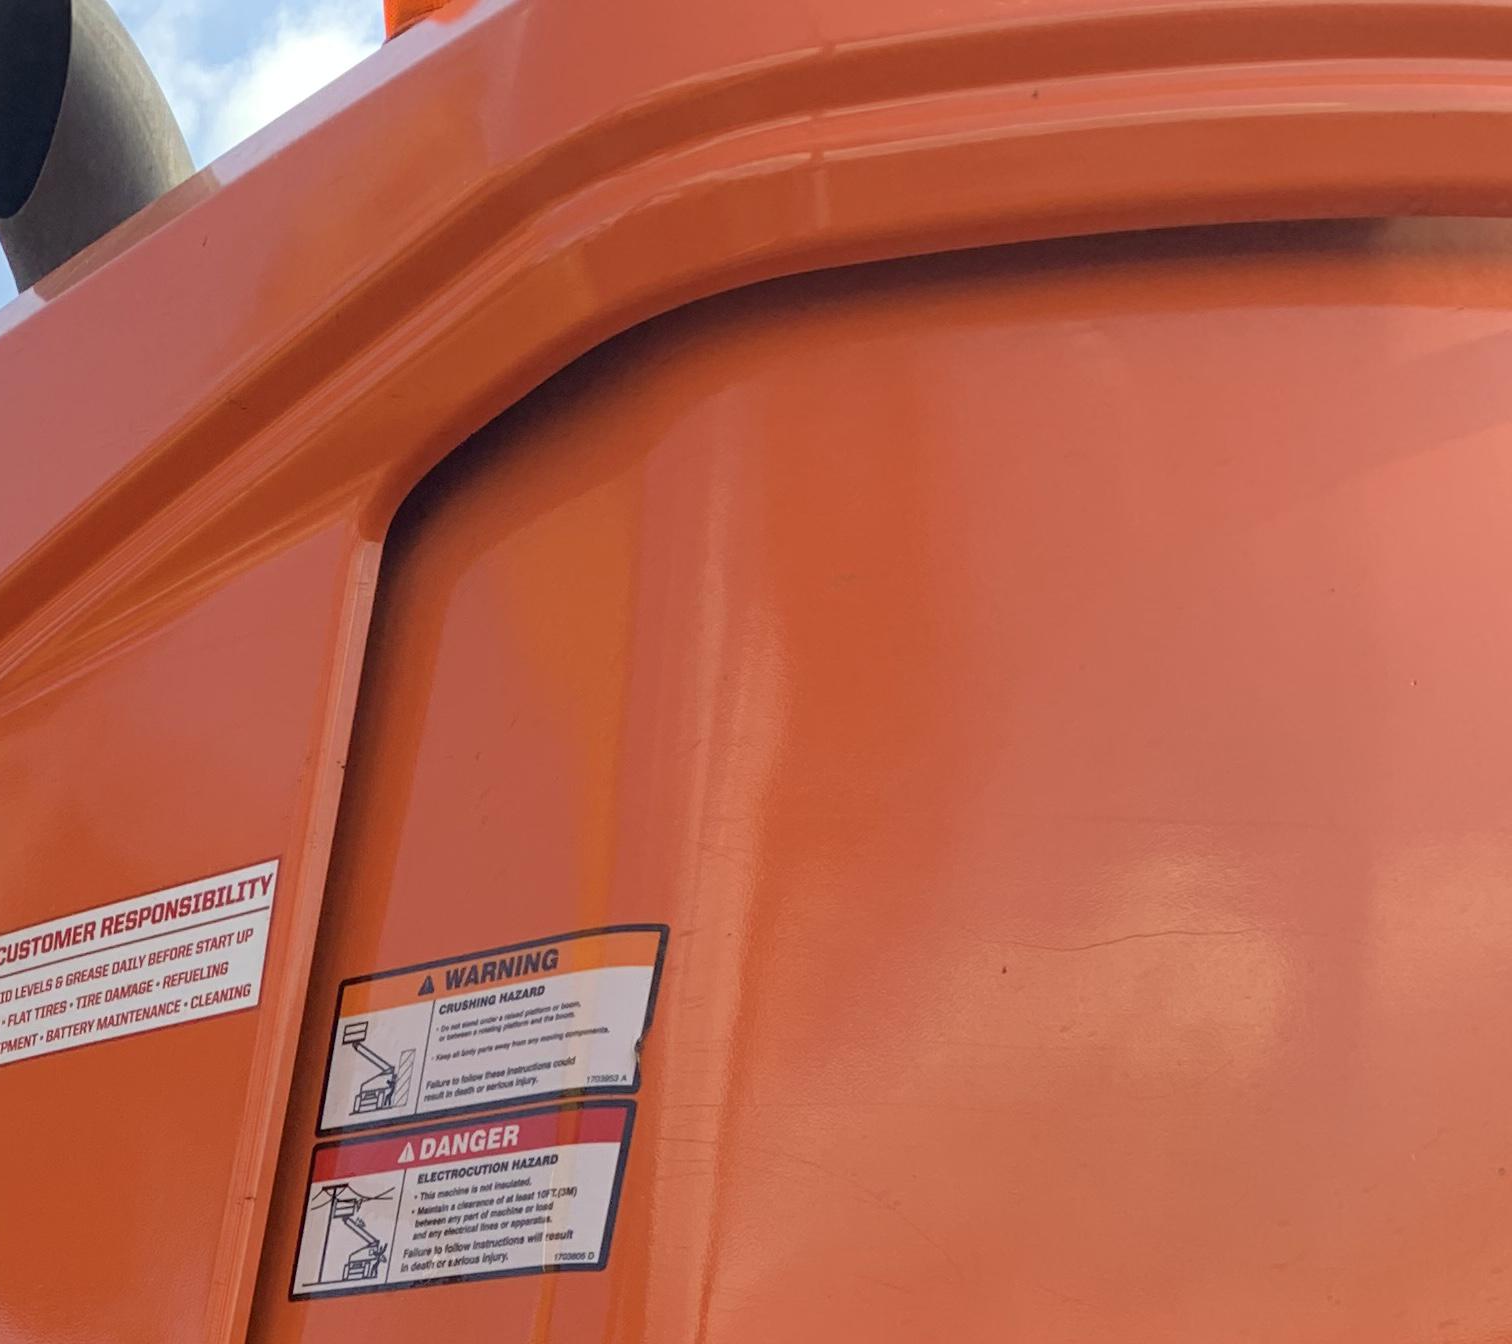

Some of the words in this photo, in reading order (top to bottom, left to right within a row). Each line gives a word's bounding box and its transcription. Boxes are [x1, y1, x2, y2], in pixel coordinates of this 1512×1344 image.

[100, 873, 273, 938] RESPONSIBILITY
[15, 979, 52, 999] LEVELS
[55, 976, 63, 989] &
[66, 964, 109, 986] GREASE
[112, 955, 146, 975] DAILY
[148, 943, 192, 966] BEFORE
[196, 933, 234, 955] START
[236, 928, 254, 944] UP
[445, 948, 559, 990] WARNING
[7, 1009, 32, 1027] FLAT
[34, 1000, 67, 1019] TIRES
[76, 992, 102, 1010] TIRE
[105, 979, 153, 1003] DAMAGE
[162, 961, 229, 989] REFUELING
[439, 996, 496, 1015] CRUSHING
[499, 985, 545, 1003] HAZARD
[46, 1020, 95, 1043] BATTERY
[96, 1000, 181, 1031] MAINTENANCE
[190, 983, 252, 1009] CLEANING
[426, 1078, 451, 1090] Failure
[461, 1073, 483, 1084] follow
[484, 1069, 506, 1080] these
[507, 1060, 552, 1075] instructions
[553, 1056, 576, 1068] could
[454, 1085, 475, 1097] death
[419, 1124, 520, 1160] DANGER
[417, 1161, 509, 1184] ELECTROCUTION
[512, 1154, 559, 1171] HAZARD
[417, 1204, 449, 1216] Maintain
[457, 1197, 494, 1210] clearance
[516, 1192, 534, 1202] least
[420, 1191, 435, 1200] This
[437, 1186, 470, 1198] machine
[480, 1184, 493, 1192] not
[415, 1216, 446, 1228] between
[448, 1215, 462, 1225] any
[463, 1212, 479, 1222] part
[490, 1206, 523, 1218] machine
[536, 1202, 554, 1211] load
[403, 1246, 432, 1259] Failure
[444, 1241, 470, 1253] follow
[472, 1234, 525, 1250] instructions
[527, 1232, 542, 1243] will
[544, 1230, 574, 1242] result
[412, 1231, 426, 1240] and
[427, 1230, 442, 1240] any
[443, 1224, 478, 1236] electrical
[480, 1222, 498, 1232] lines
[410, 1259, 435, 1272] death
[482, 1252, 509, 1266] injury.
